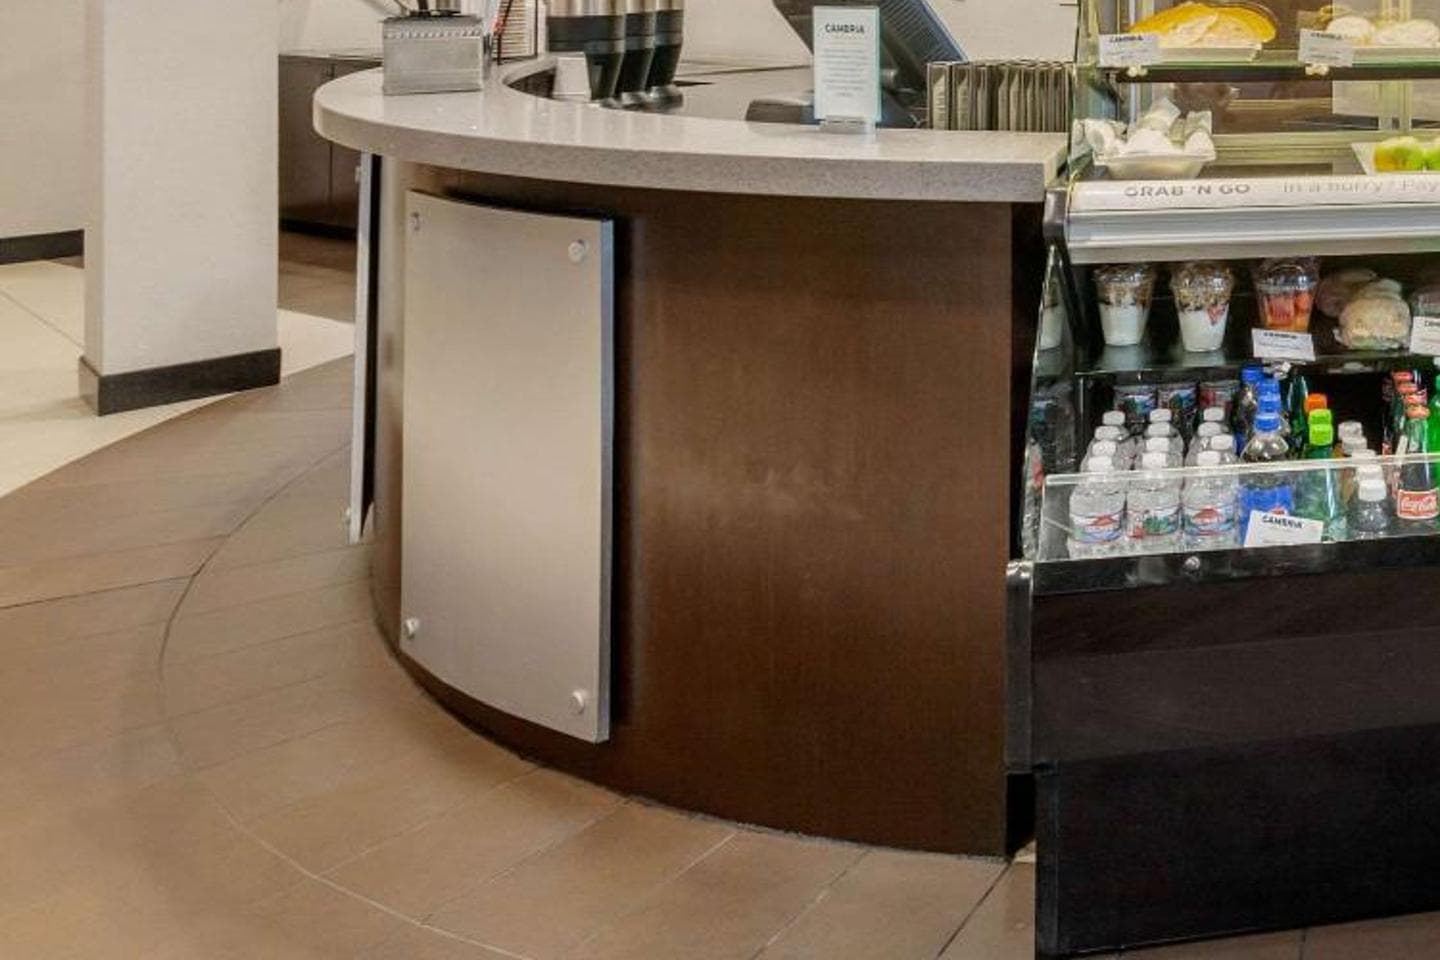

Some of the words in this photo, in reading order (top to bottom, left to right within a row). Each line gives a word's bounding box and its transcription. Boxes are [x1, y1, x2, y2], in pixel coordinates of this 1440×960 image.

[825, 22, 865, 34] CAMBRIA
[1124, 185, 1184, 198] GRAB
[1219, 183, 1250, 195] GO
[1261, 514, 1303, 529] CAMBRIA
